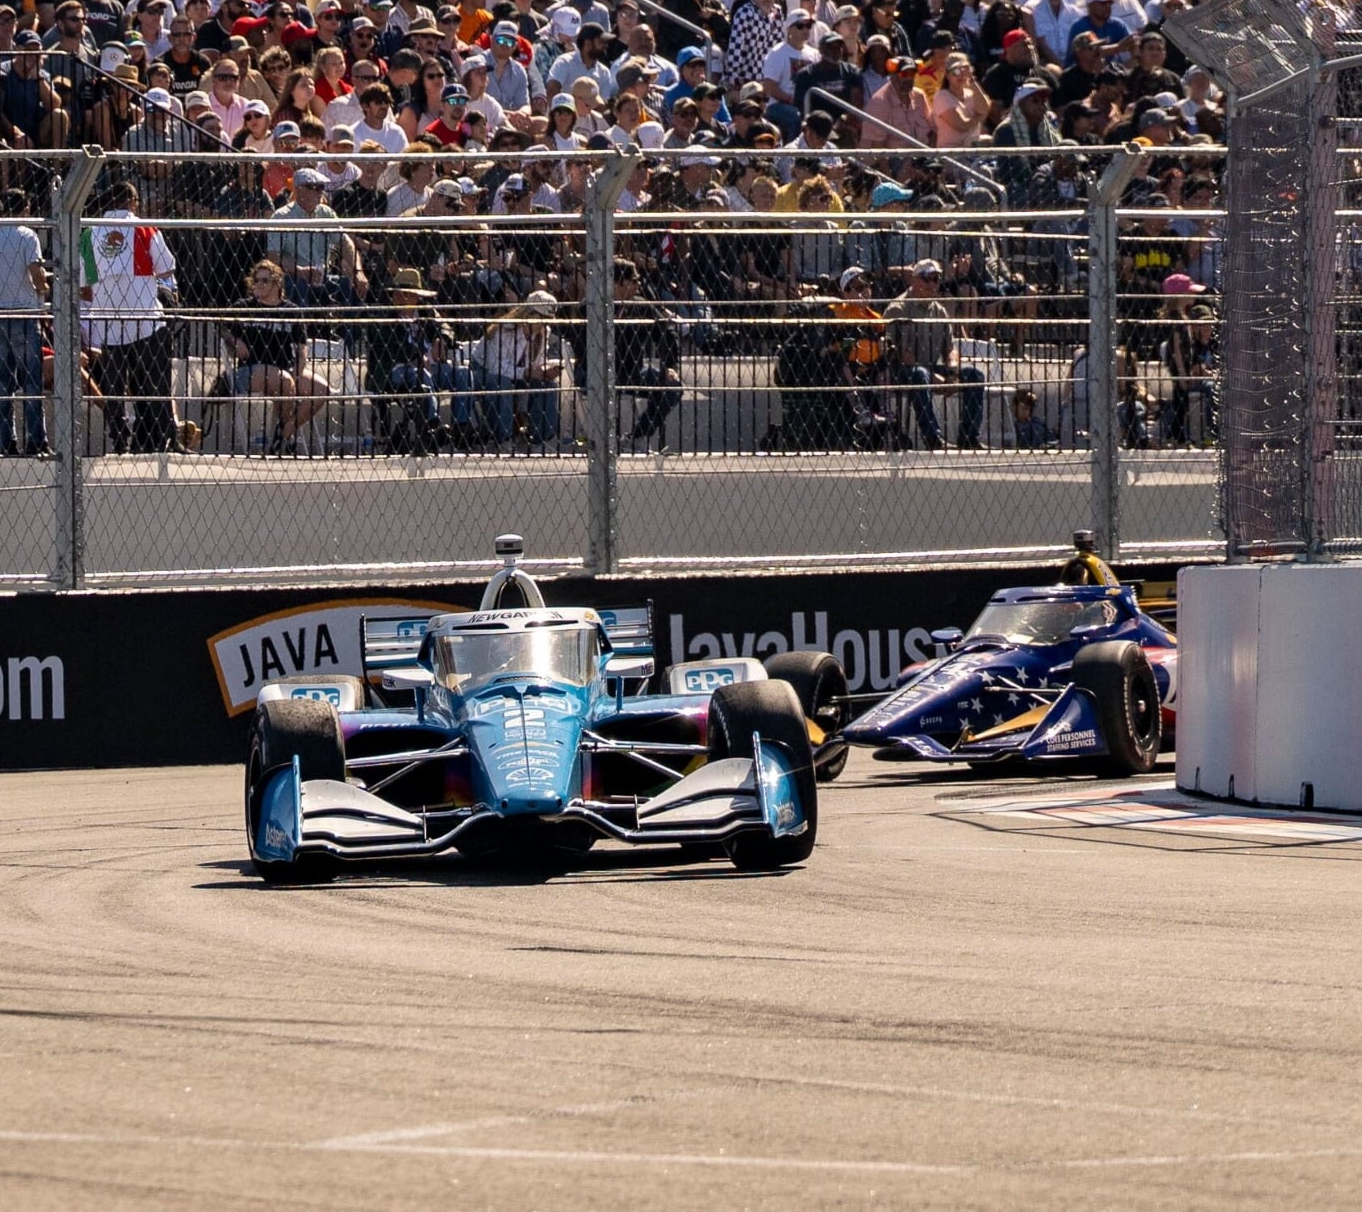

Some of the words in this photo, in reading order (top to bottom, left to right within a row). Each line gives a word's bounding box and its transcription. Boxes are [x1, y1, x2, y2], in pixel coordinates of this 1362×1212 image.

[467, 611, 563, 624] NEWGAN
[239, 623, 339, 688] JAVA
[687, 671, 733, 691] PPG
[503, 709, 545, 729] 2
